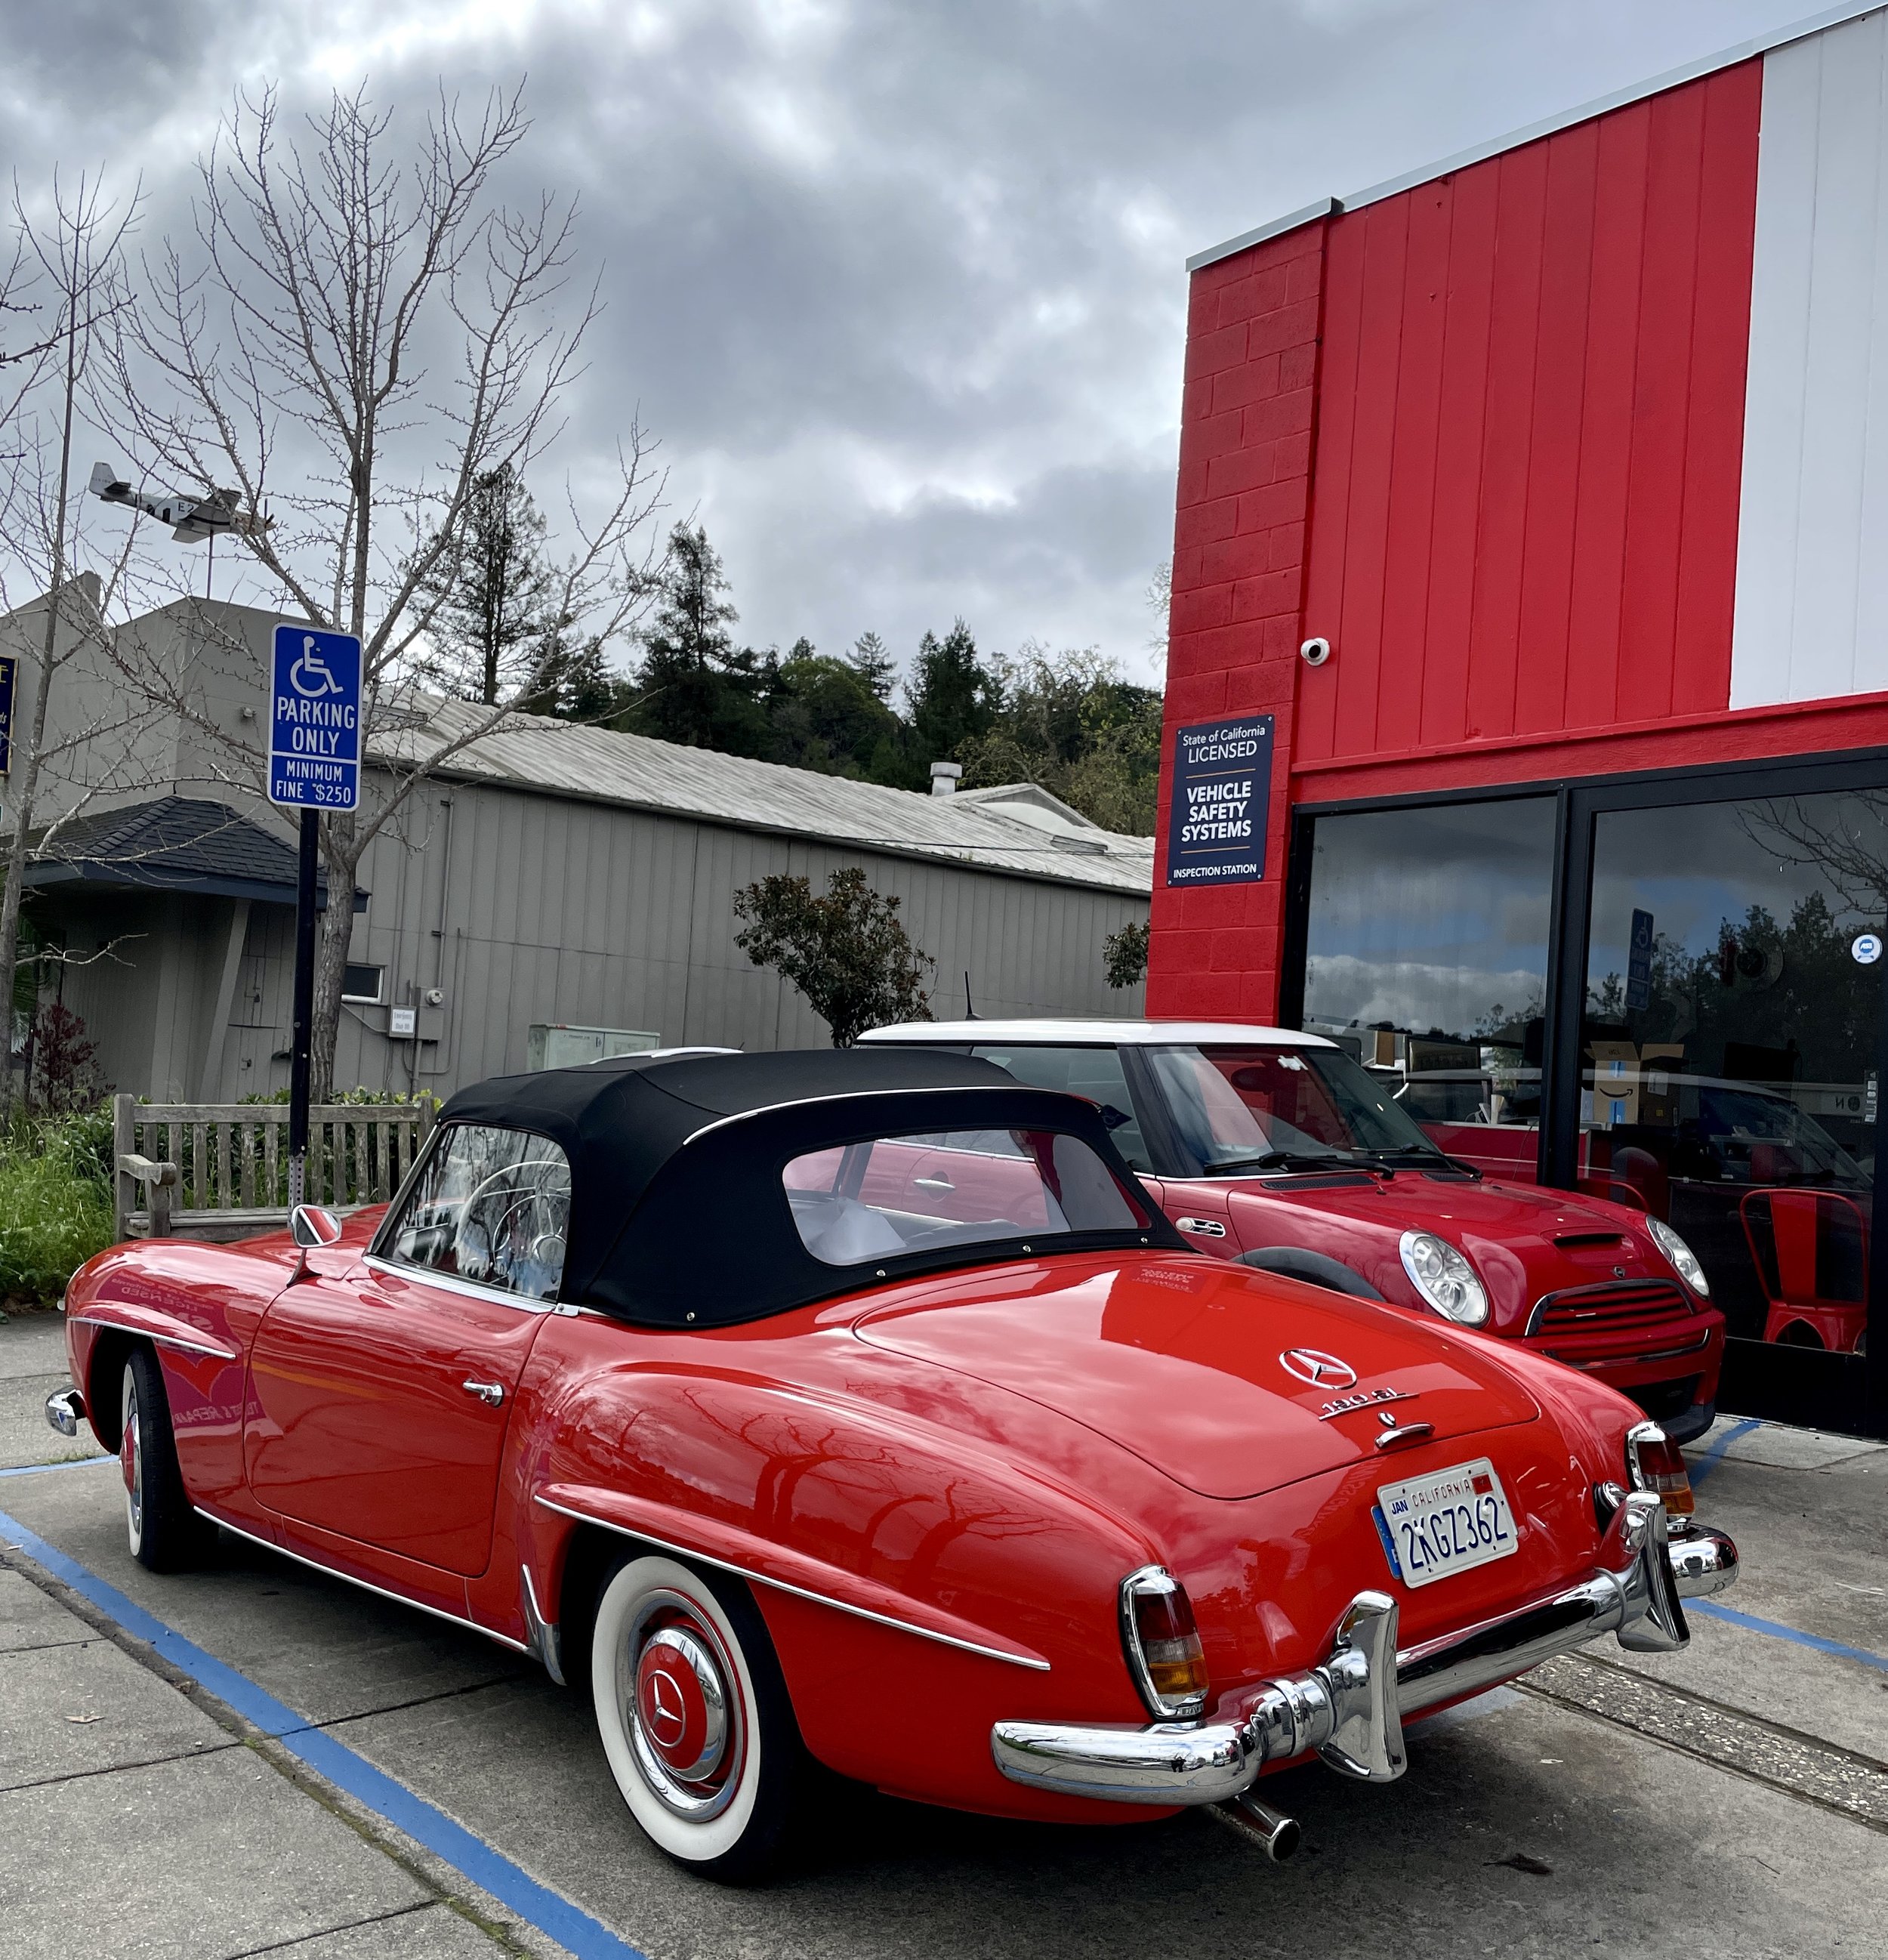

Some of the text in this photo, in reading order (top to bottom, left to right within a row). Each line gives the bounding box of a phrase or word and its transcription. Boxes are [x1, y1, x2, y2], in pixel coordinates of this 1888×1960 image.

[277, 696, 355, 729] PARKING
[292, 727, 340, 755] ONLY
[1183, 724, 1266, 746] State of California
[1188, 740, 1257, 764] LICENSED
[286, 760, 342, 782] MINIMUM
[276, 779, 351, 804] FINE $250
[1186, 781, 1252, 804] VEHICLE
[1189, 801, 1248, 823] SAFETY
[1181, 819, 1252, 843] SYSTEMS
[1173, 863, 1257, 879] INSPECTION STATION
[1321, 1394, 1368, 1412] 190
[1391, 1499, 1408, 1516] JAN
[1411, 1479, 1472, 1507] CALIFORNIA
[1401, 1496, 1508, 1570] 2KGZ362
